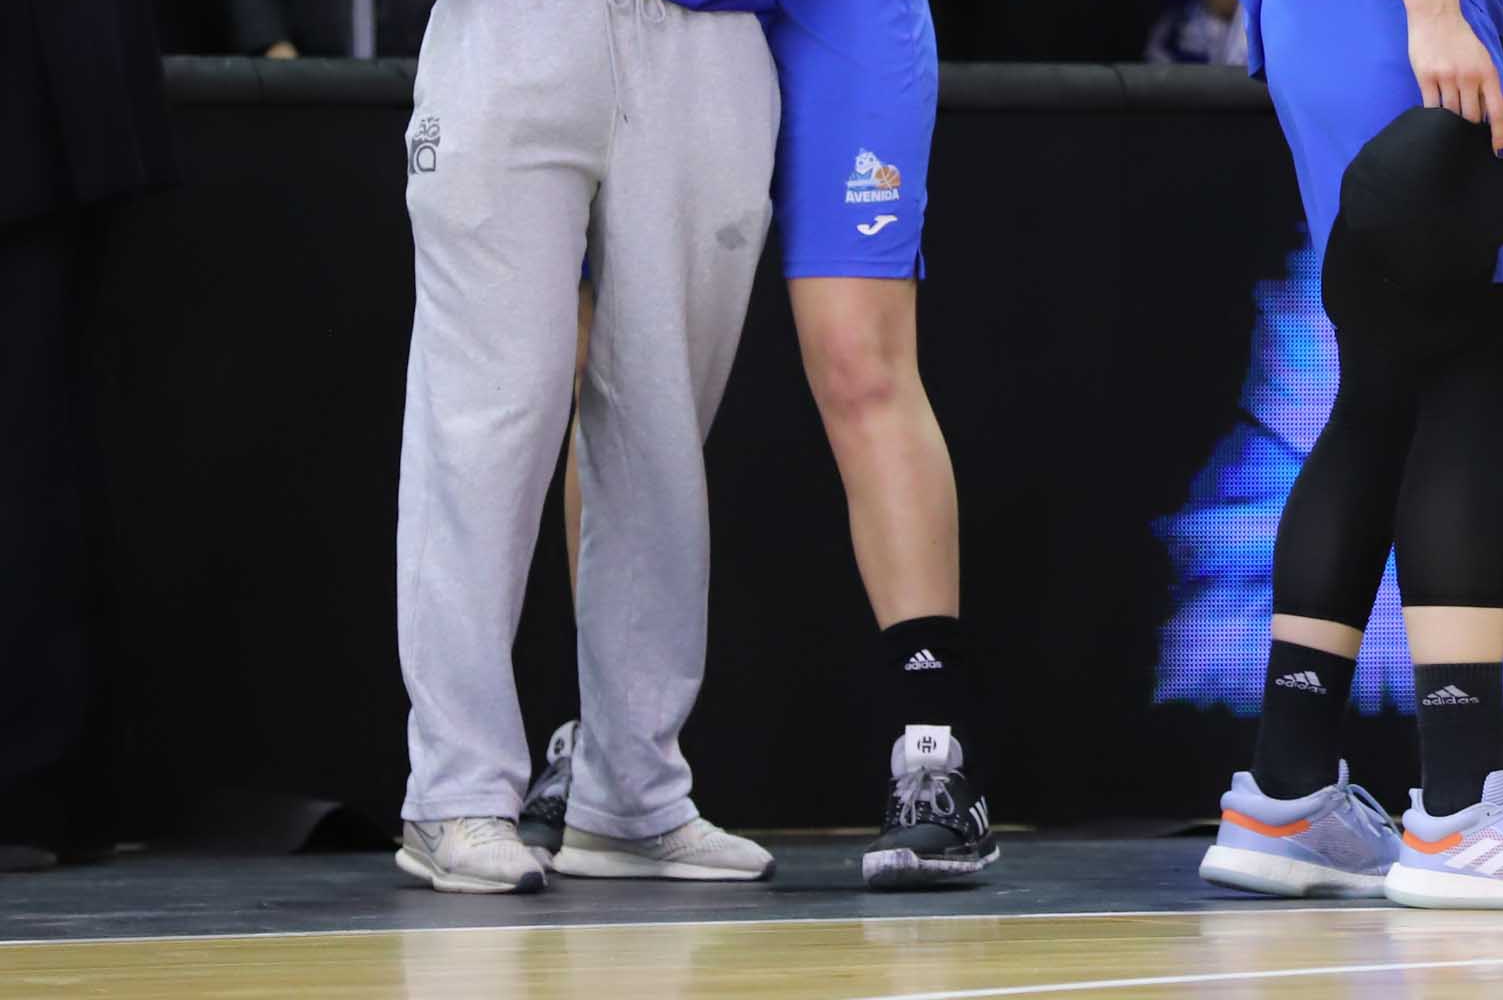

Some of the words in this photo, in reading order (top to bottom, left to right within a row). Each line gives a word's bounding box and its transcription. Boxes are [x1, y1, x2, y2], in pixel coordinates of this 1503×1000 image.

[845, 189, 900, 204] AVENIDA
[904, 660, 942, 671] adidas
[1275, 677, 1328, 695] adidas
[1422, 696, 1480, 706] adidas
